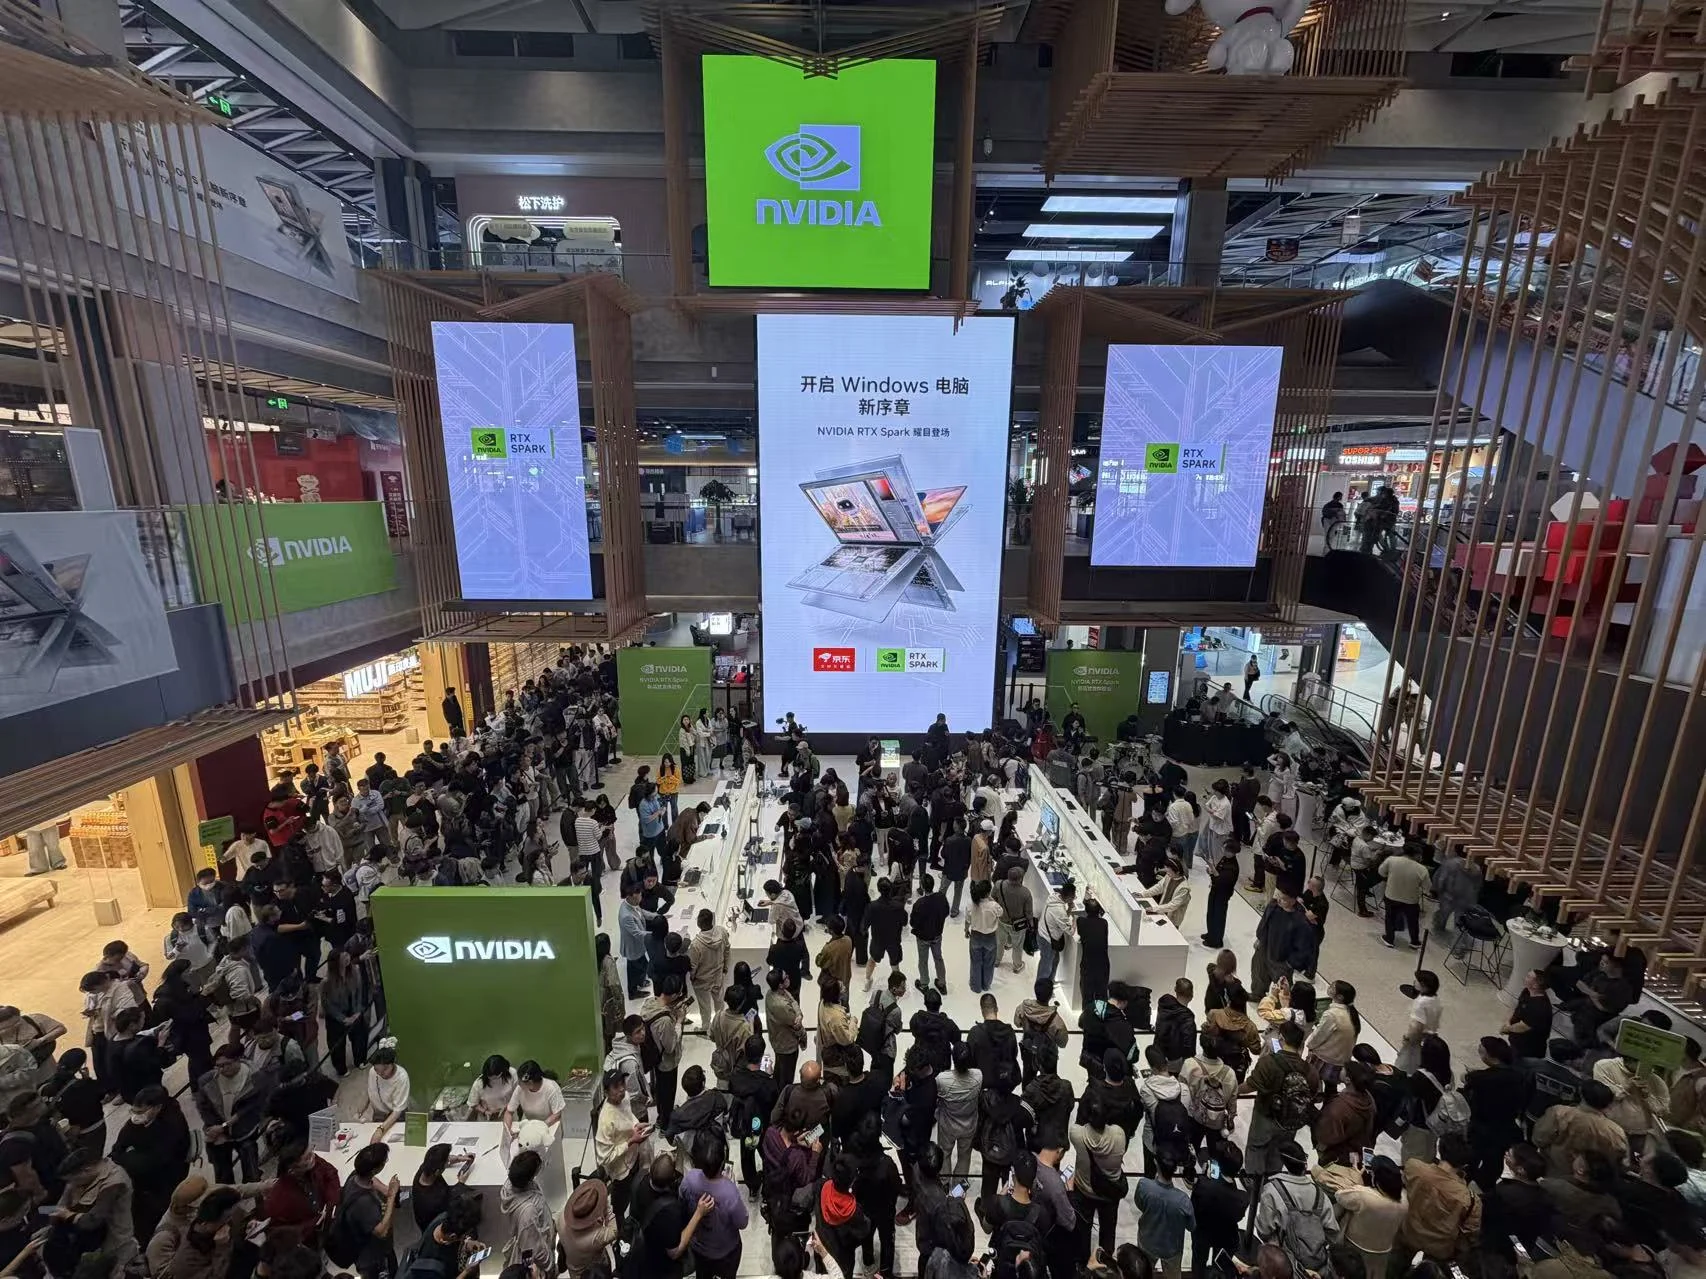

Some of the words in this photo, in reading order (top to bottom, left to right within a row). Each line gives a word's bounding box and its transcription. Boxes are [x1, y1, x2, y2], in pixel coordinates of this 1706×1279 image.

[518, 195, 565, 210] 松下洗护
[756, 199, 882, 227] NVIDIA
[800, 375, 835, 394] 开启
[841, 376, 929, 394] Windows
[936, 376, 970, 395] 电脑
[858, 397, 911, 417] 新序章
[817, 427, 855, 437] NVIDIA
[857, 427, 878, 437] RTX
[880, 427, 911, 438] Spark
[913, 427, 951, 438] 耀目登场
[510, 433, 531, 443] RTX
[511, 444, 547, 453] SPARK
[1183, 449, 1204, 458] RTX
[1182, 460, 1216, 469] SPARK
[1339, 455, 1381, 464] TOSHIBA
[284, 535, 353, 561] NVIDIA
[832, 655, 851, 663] 京东
[909, 652, 927, 660] RTX
[654, 665, 687, 673] NVIDIA
[1087, 667, 1120, 675] NVIDIA
[344, 661, 389, 699] MUJI
[454, 941, 556, 960] NVIDIA
